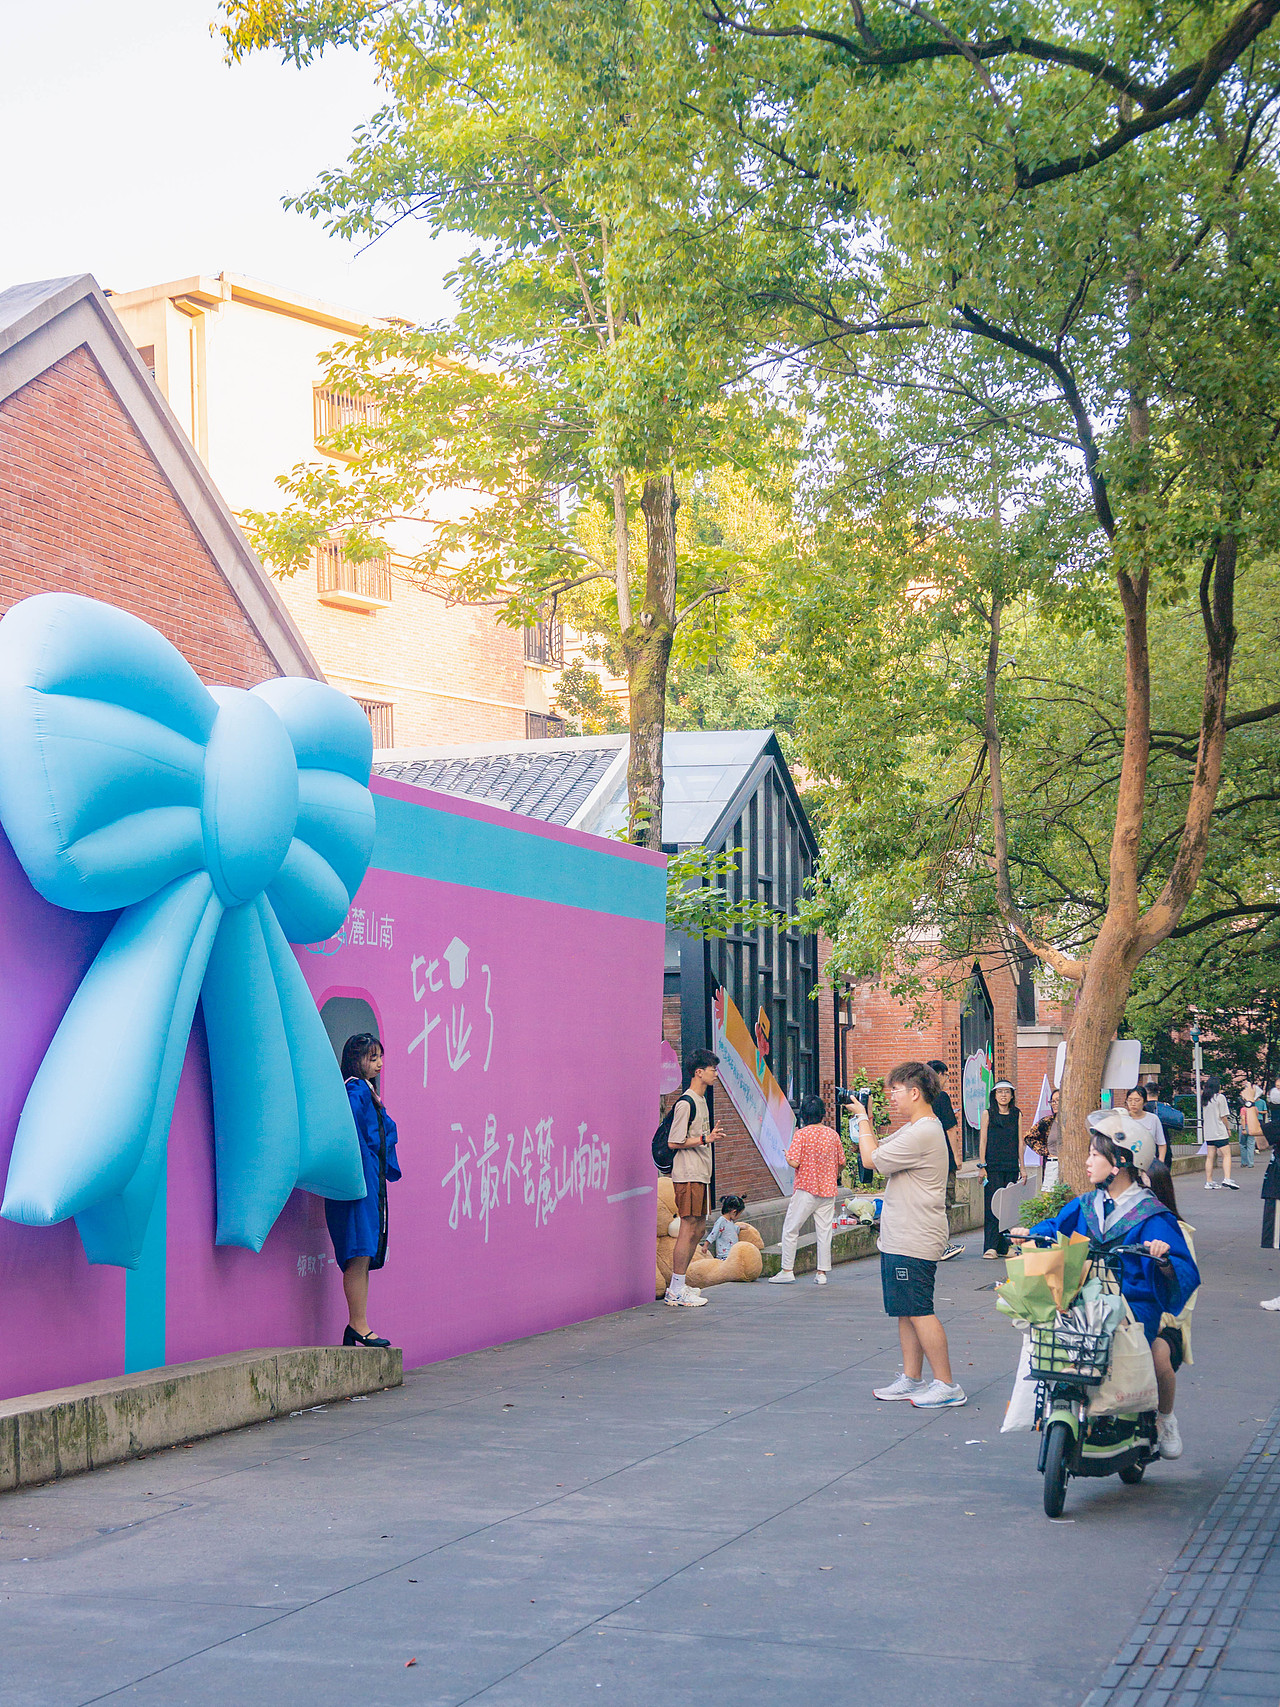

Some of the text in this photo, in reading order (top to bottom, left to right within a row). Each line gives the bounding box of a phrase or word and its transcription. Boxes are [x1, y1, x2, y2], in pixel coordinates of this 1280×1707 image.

[331, 907, 395, 950] 麓山南
[296, 1252, 340, 1277] 领取下一
